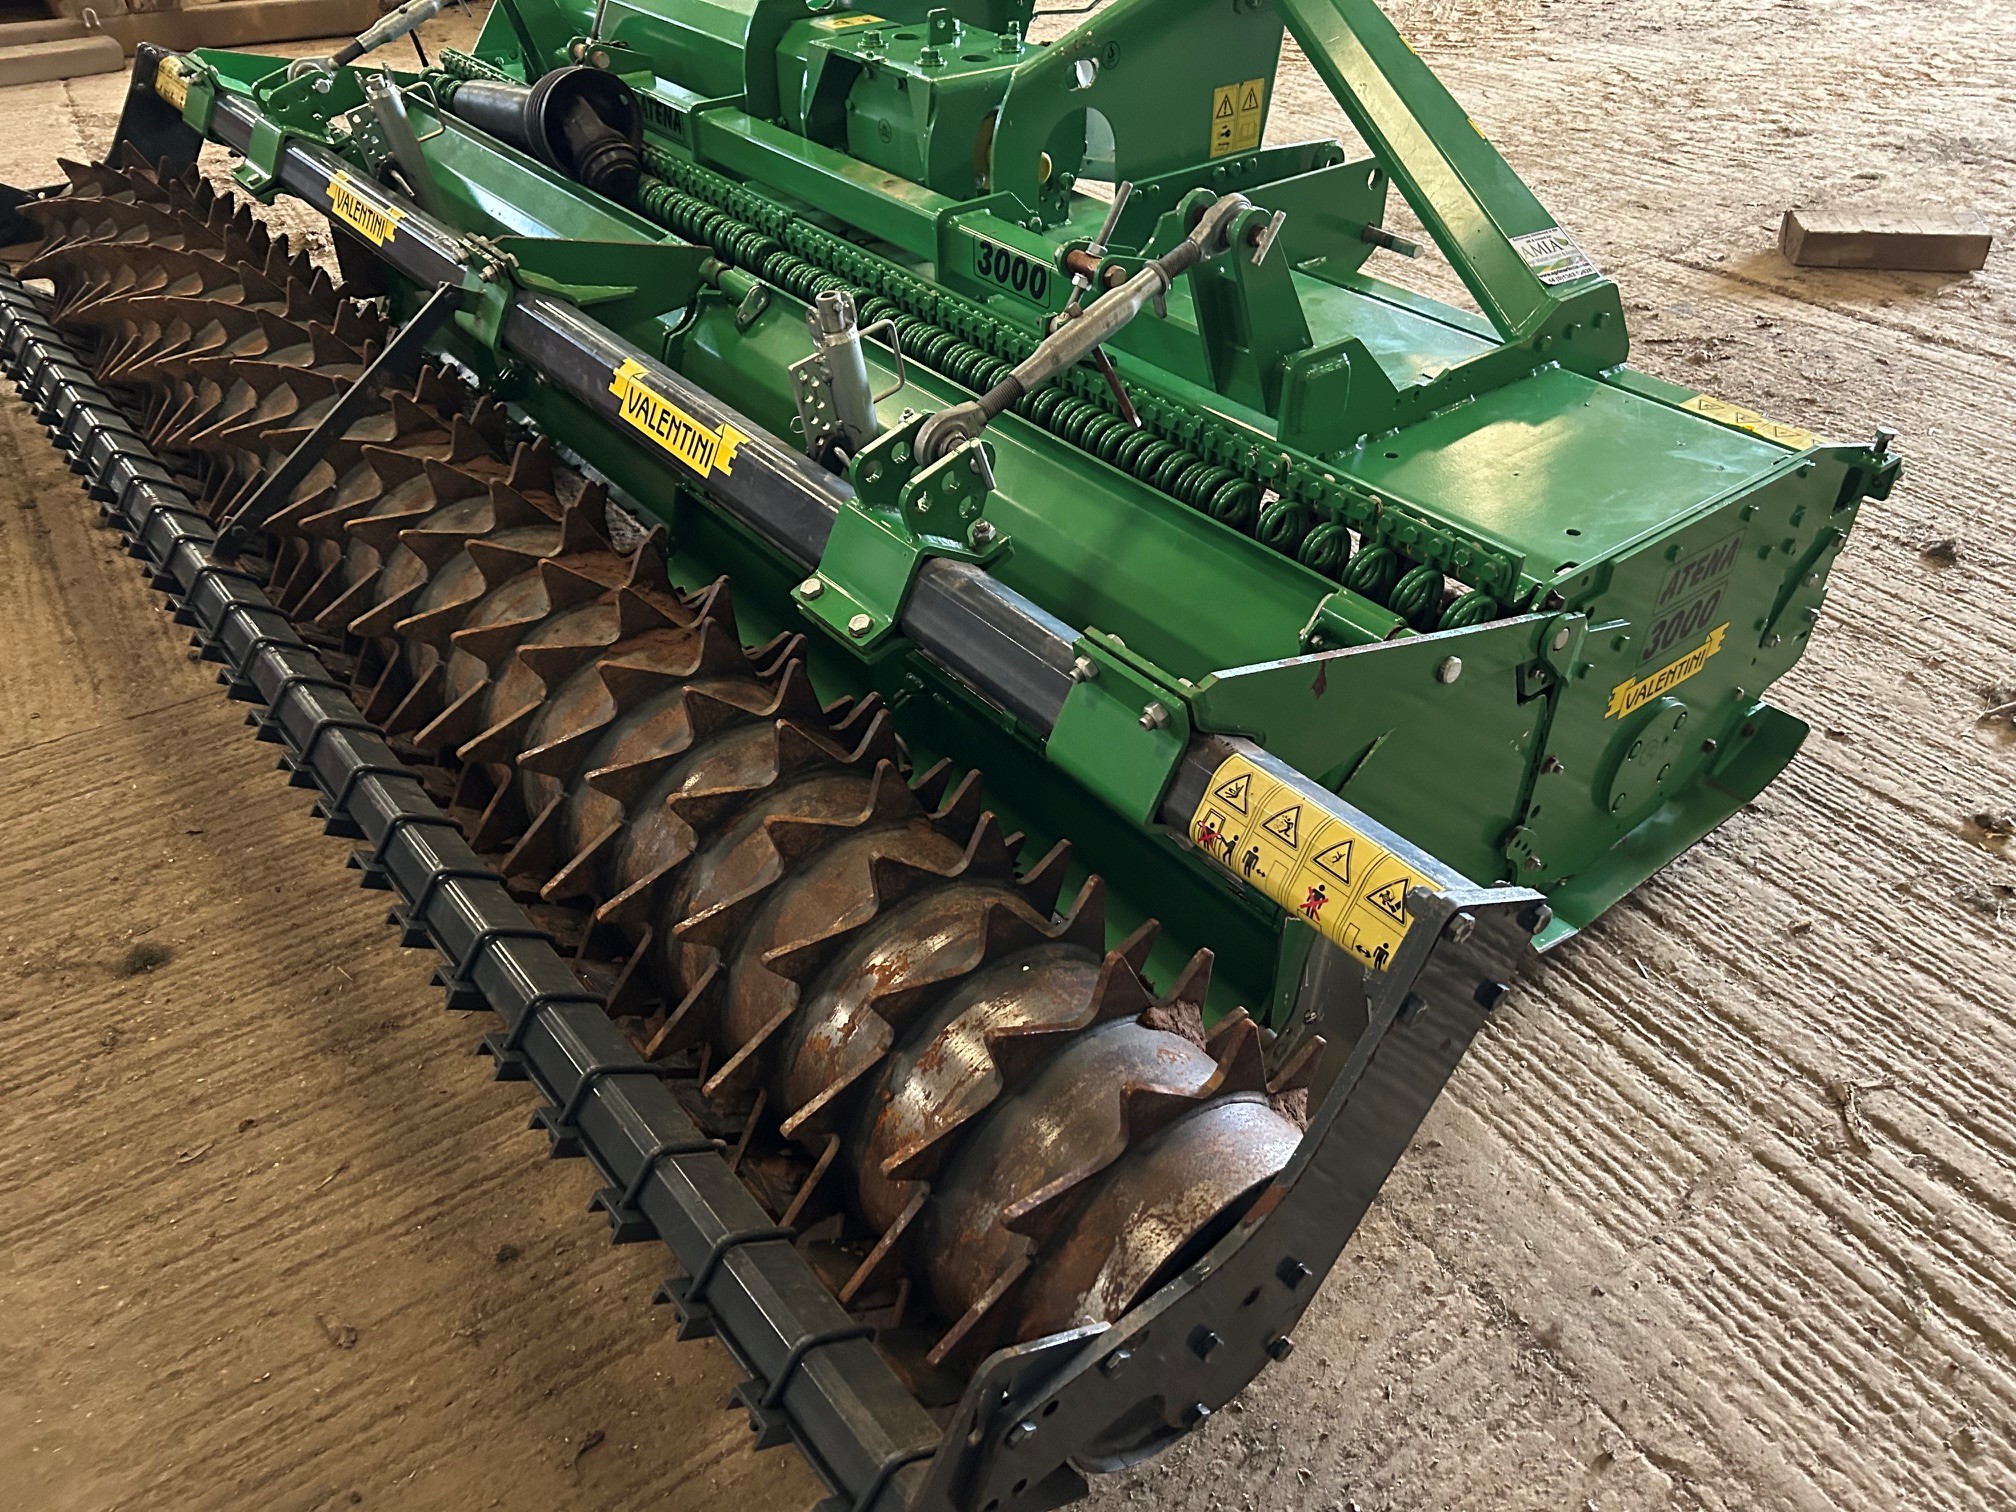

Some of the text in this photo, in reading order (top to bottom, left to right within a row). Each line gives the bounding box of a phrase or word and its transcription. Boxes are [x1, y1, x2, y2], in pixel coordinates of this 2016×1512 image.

[640, 93, 683, 135] ATENA
[336, 187, 386, 240] VALENTINI
[977, 239, 1047, 300] 3000
[1521, 238, 1563, 259] AMIA
[628, 386, 715, 469] VALENTINI
[1660, 537, 1740, 605] ATENA
[1642, 589, 1722, 661] 3000
[1625, 648, 1707, 710] VALENTINI
